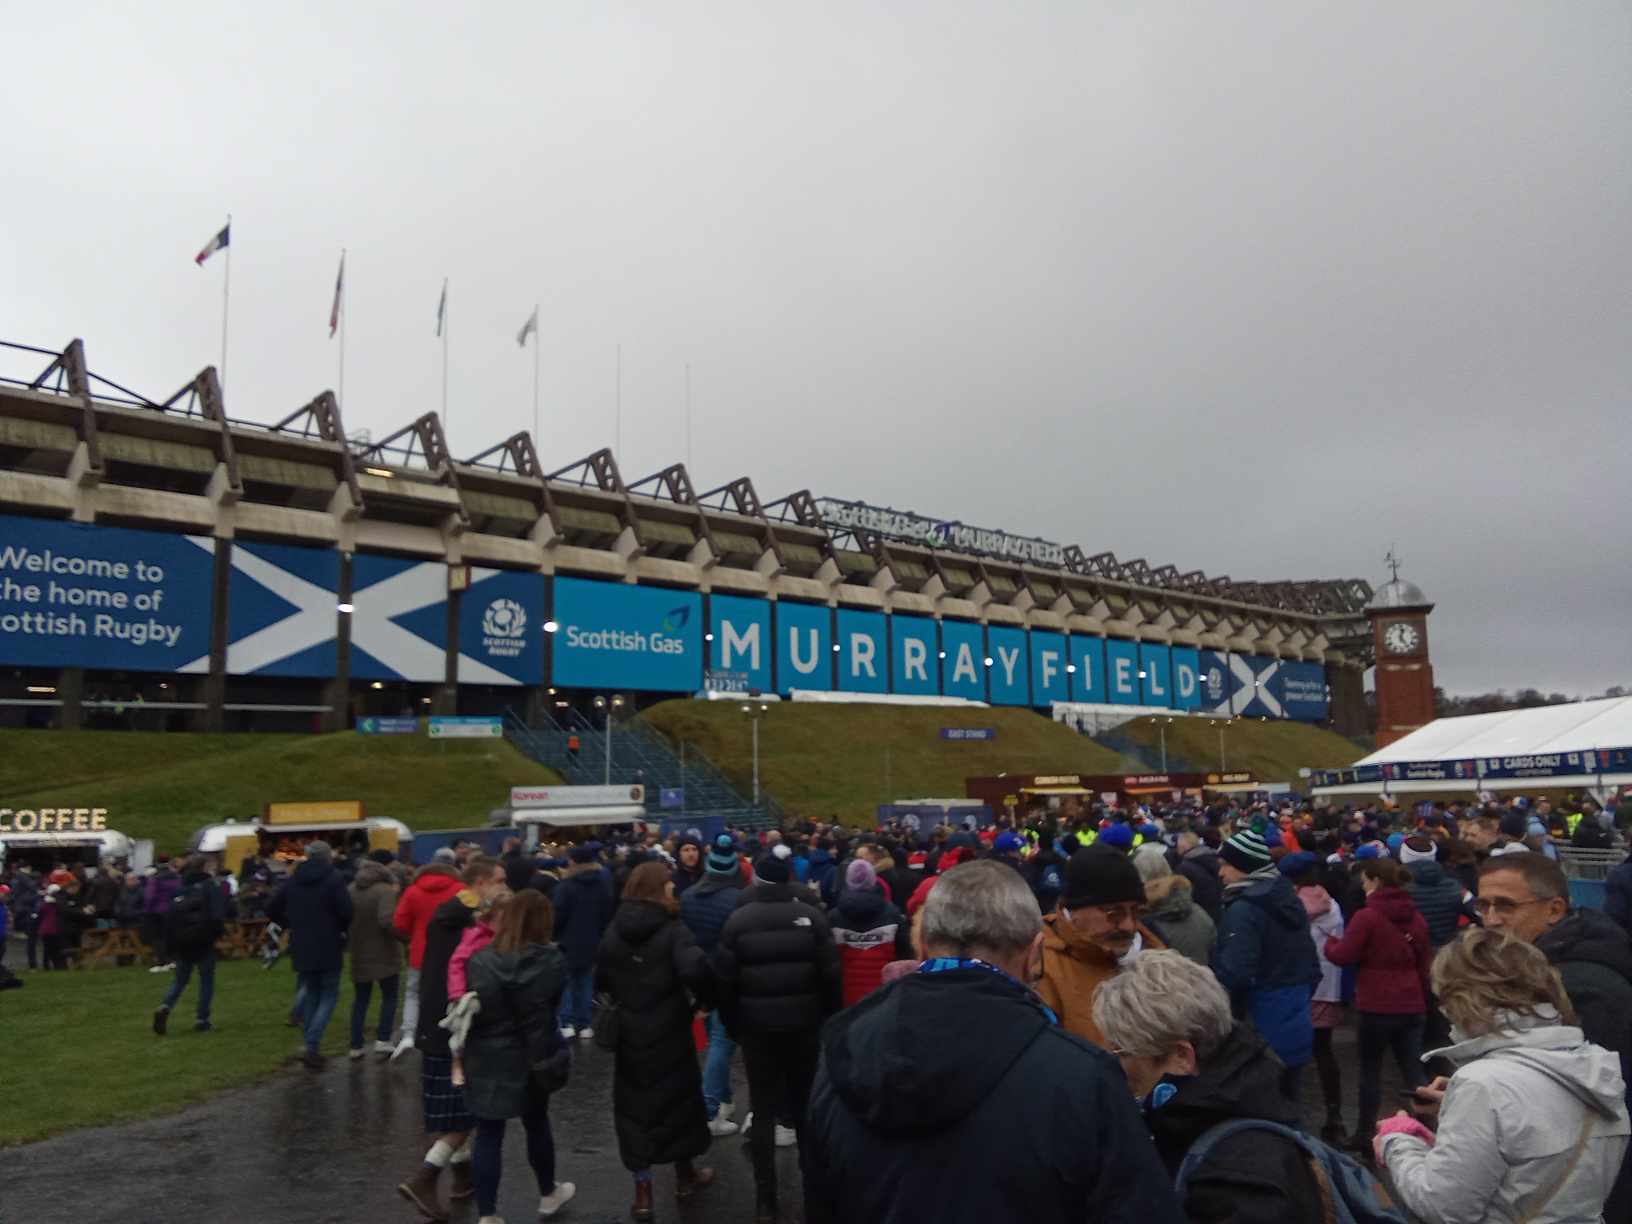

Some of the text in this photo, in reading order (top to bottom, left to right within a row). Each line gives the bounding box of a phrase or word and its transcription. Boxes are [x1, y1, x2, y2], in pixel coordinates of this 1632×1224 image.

[0, 546, 164, 582] Welcome to
[0, 577, 164, 611] he home of
[0, 611, 182, 647] ottish Rugby
[566, 625, 684, 654] Scottish Gas
[721, 619, 1195, 698] MURRAYFIELD
[0, 808, 108, 832] COFFEE
